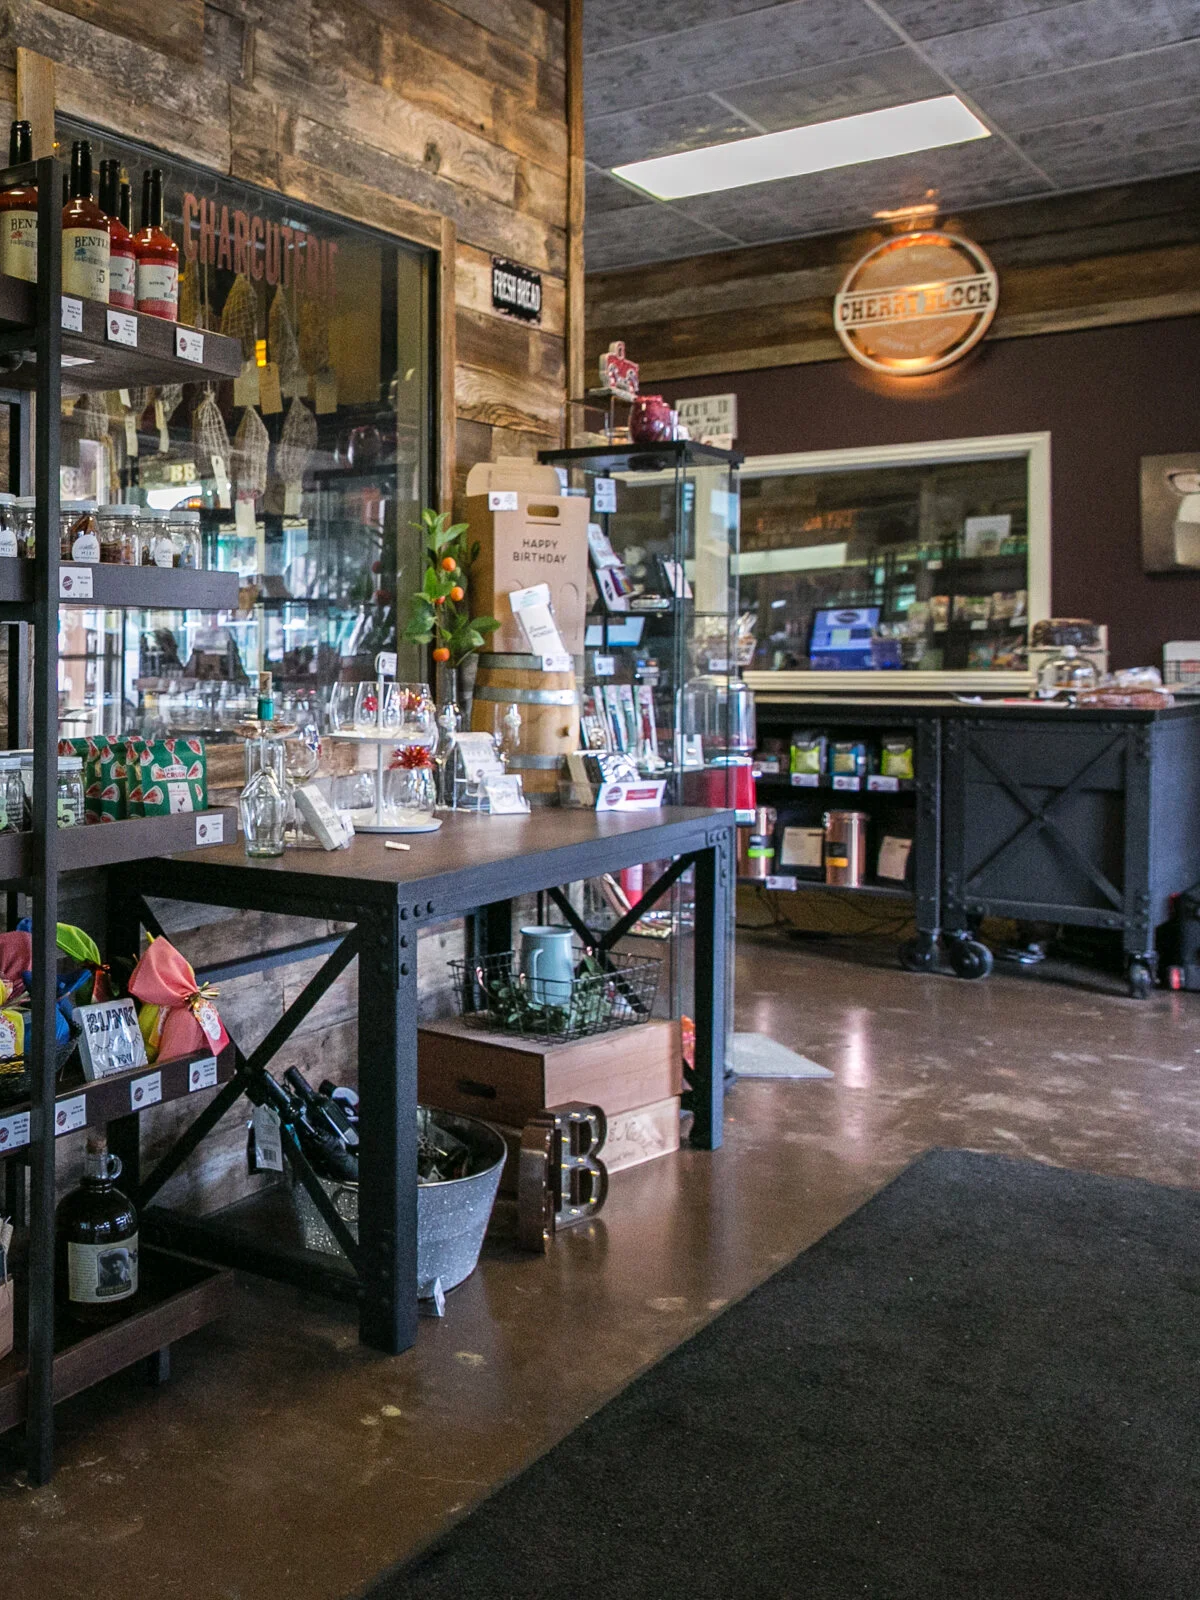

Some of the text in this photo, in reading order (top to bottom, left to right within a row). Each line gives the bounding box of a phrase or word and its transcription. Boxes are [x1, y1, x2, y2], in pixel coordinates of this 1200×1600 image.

[182, 191, 339, 296] CHARCUTERIE
[493, 269, 540, 312] FRESH BREAD
[840, 282, 993, 322] CHERRY BLOCK
[512, 552, 567, 564] BIRTHDAY
[522, 538, 559, 549] HAPPY
[86, 1006, 137, 1034] BLINK
